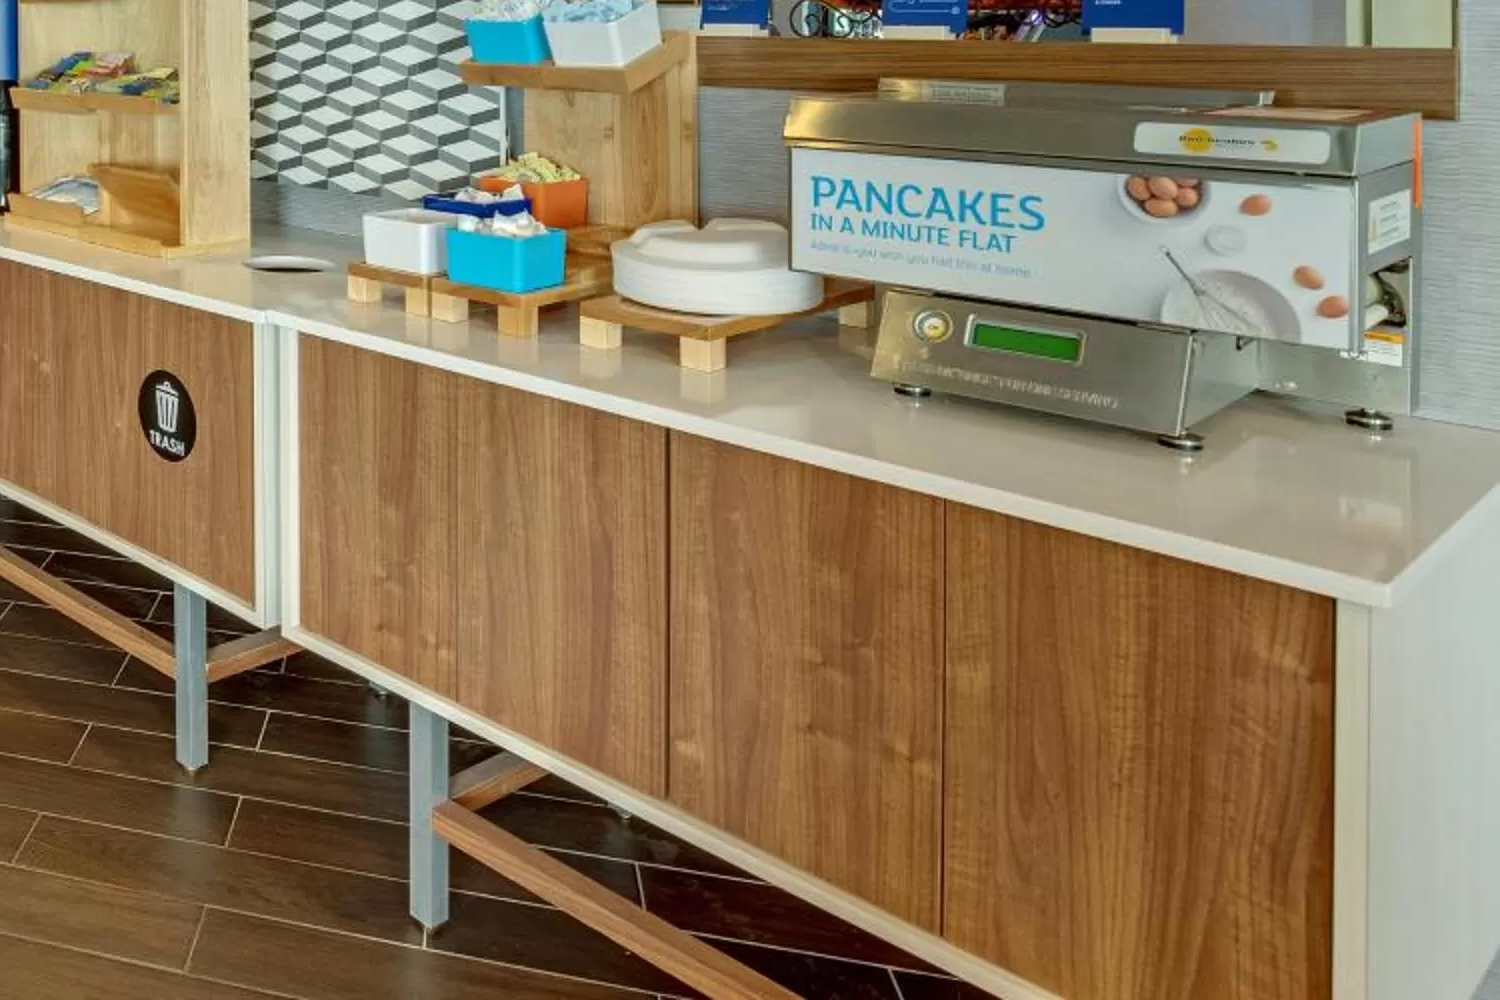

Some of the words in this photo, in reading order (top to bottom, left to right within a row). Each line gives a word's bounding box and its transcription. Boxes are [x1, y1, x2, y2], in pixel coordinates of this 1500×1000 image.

[810, 175, 1045, 232] PANCAKES
[810, 213, 833, 232] IN
[839, 217, 855, 235] A
[861, 219, 951, 246] MINUTE
[959, 229, 1018, 254] FLAT
[149, 429, 185, 456] TRASH
